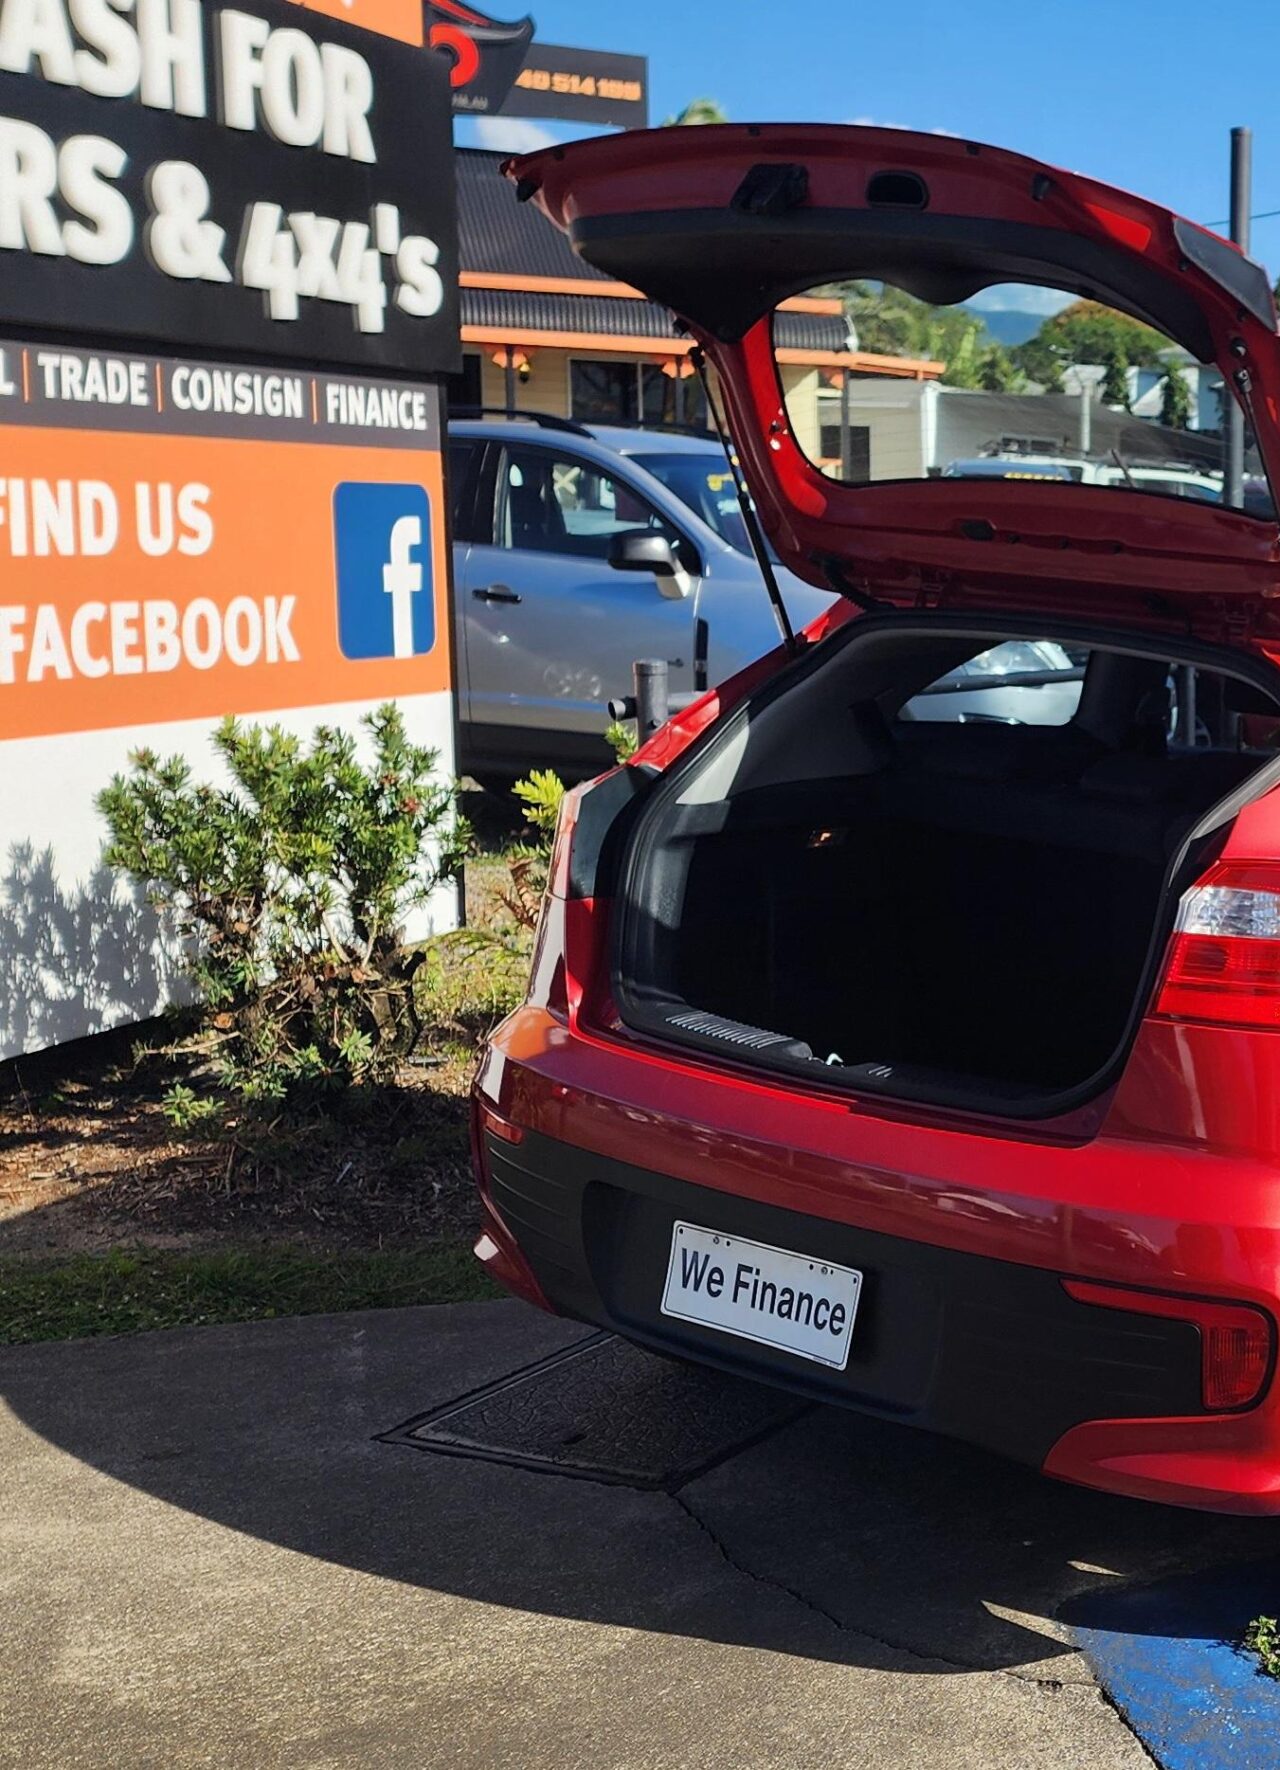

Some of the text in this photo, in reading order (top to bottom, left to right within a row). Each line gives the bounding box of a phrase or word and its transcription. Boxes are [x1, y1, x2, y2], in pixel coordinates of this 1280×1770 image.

[218, 9, 377, 164] FOR
[150, 160, 232, 283] &
[37, 352, 149, 407] TRADE
[171, 366, 303, 418] CONSIGN
[326, 383, 428, 431] FINANCE
[0, 478, 214, 557] IND US
[0, 594, 301, 685] FACEBOOK
[681, 1248, 846, 1336] We Finance
